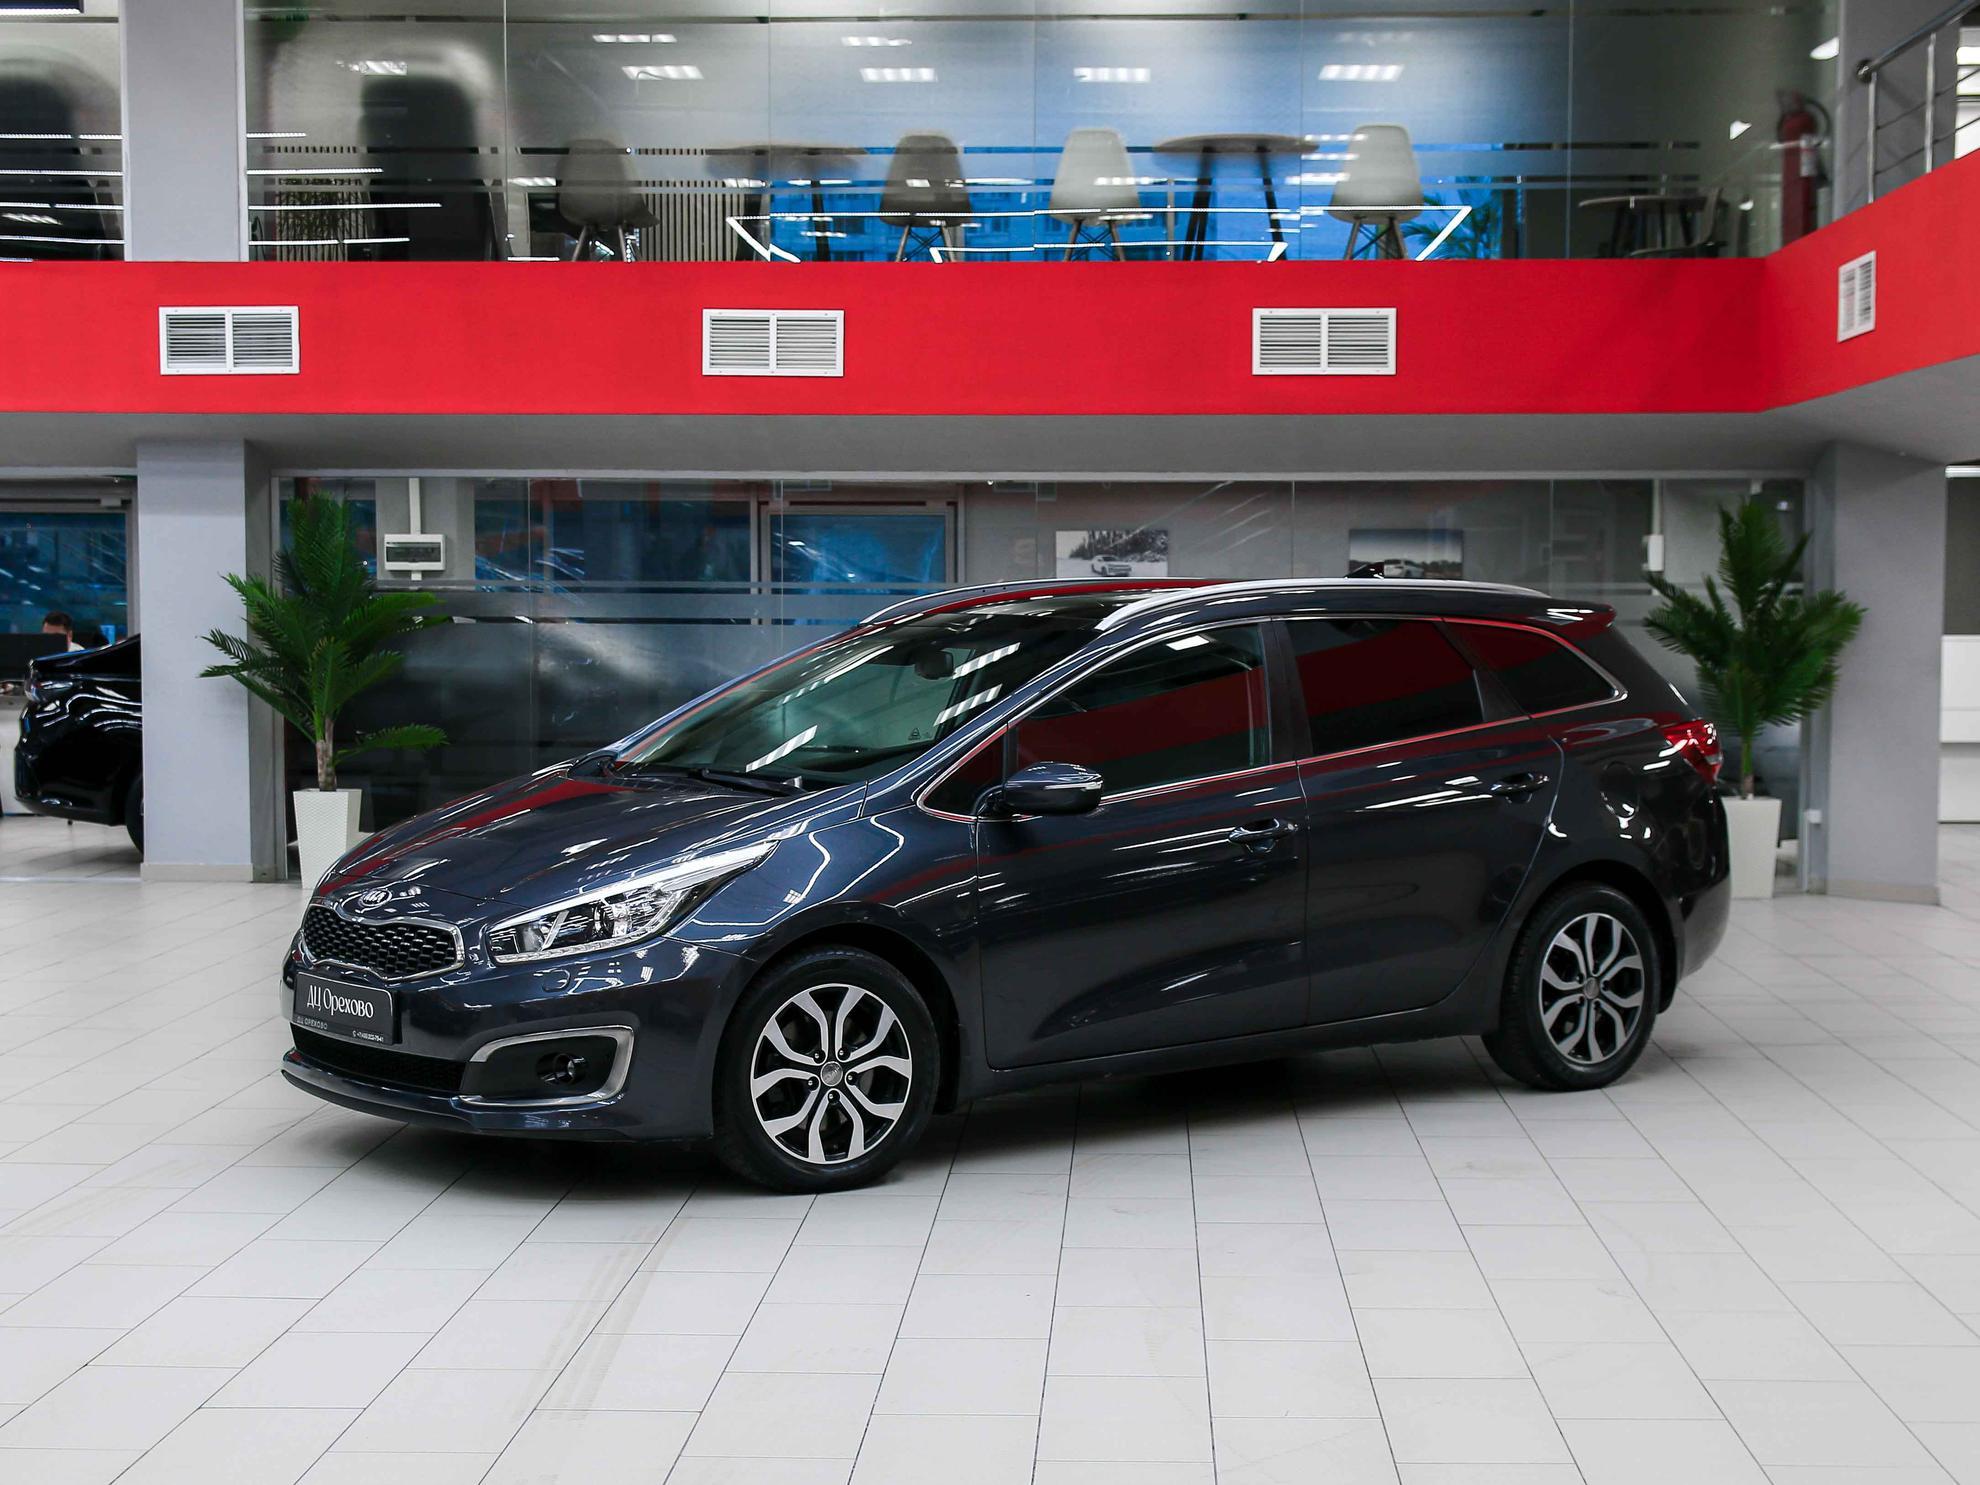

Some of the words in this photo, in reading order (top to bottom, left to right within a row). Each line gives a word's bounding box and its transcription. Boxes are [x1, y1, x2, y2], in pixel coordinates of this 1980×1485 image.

[363, 890, 386, 903] KIA
[306, 985, 322, 1012] ДЦ
[323, 988, 374, 1018] Орехово
